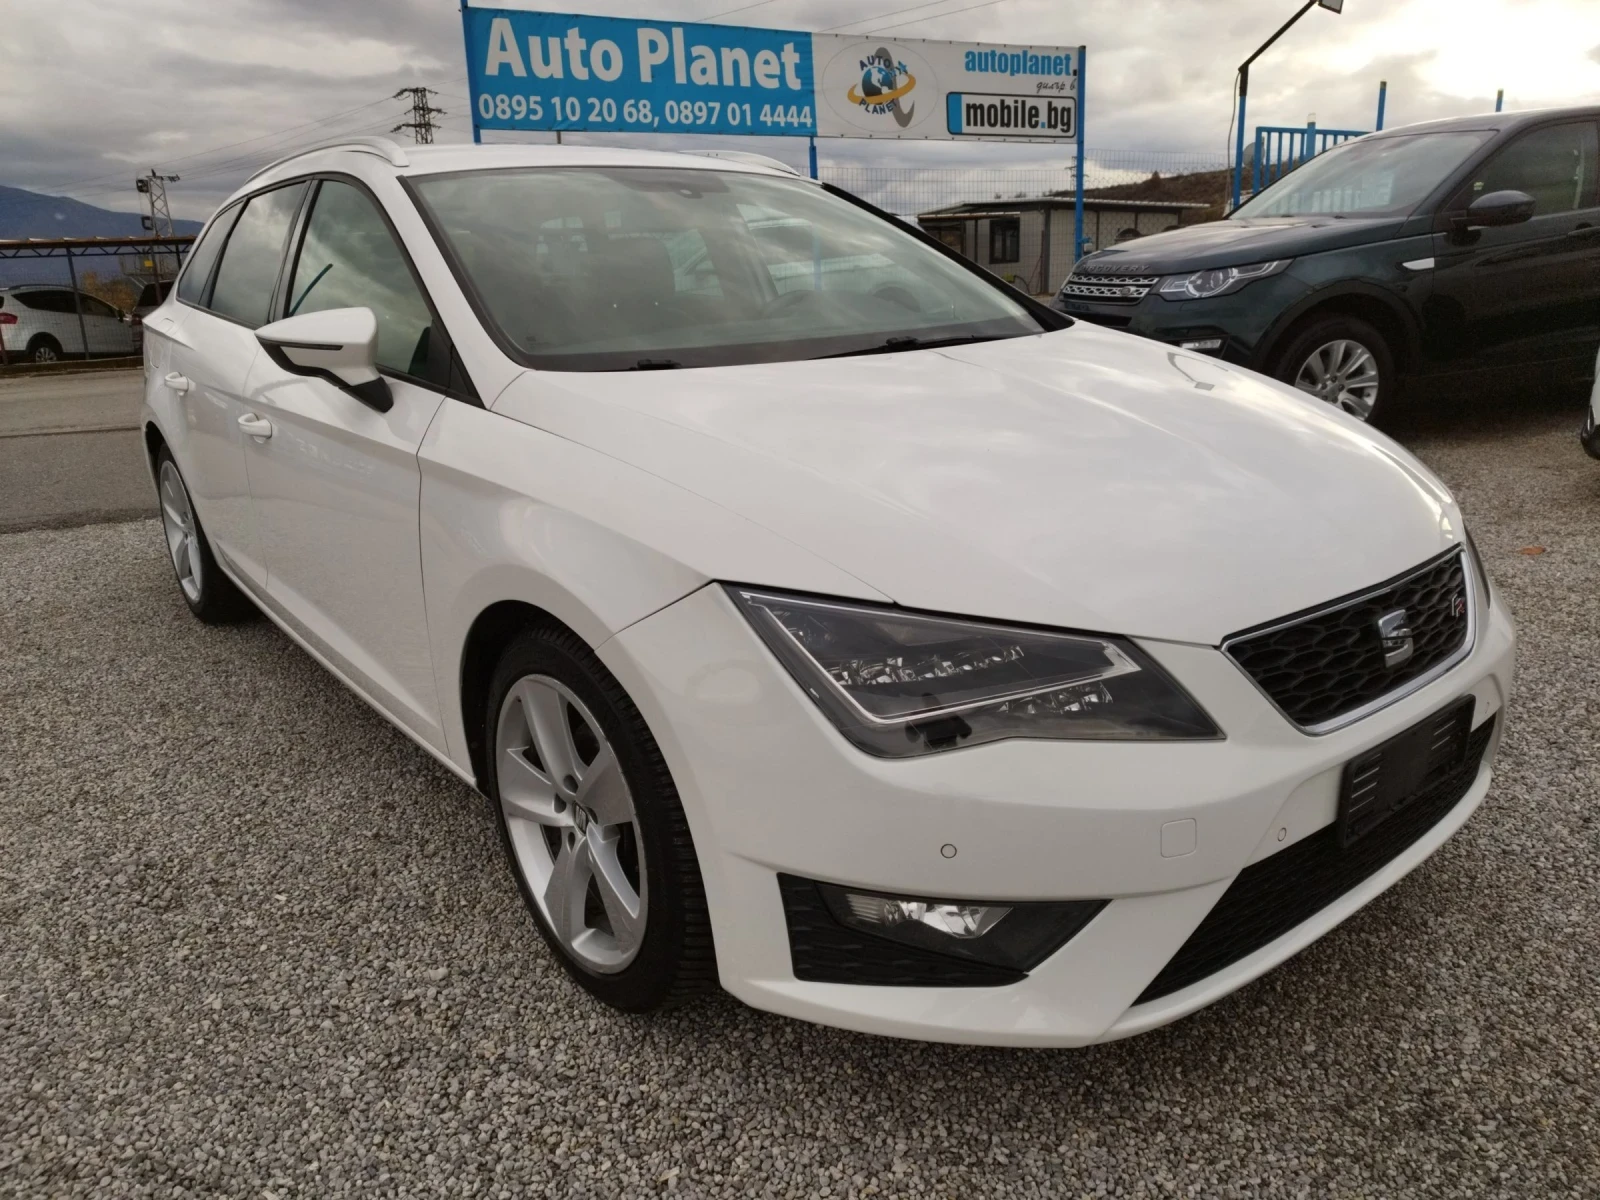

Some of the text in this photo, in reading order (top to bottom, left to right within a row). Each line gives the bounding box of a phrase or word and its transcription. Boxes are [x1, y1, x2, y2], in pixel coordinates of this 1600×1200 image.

[485, 17, 802, 90] Auto Planet
[859, 55, 891, 71] AUTO
[478, 93, 813, 128] 0895 10 20 68, 0897 01 4444
[859, 98, 897, 115] PLANET
[965, 99, 1072, 133] mobile.bg
